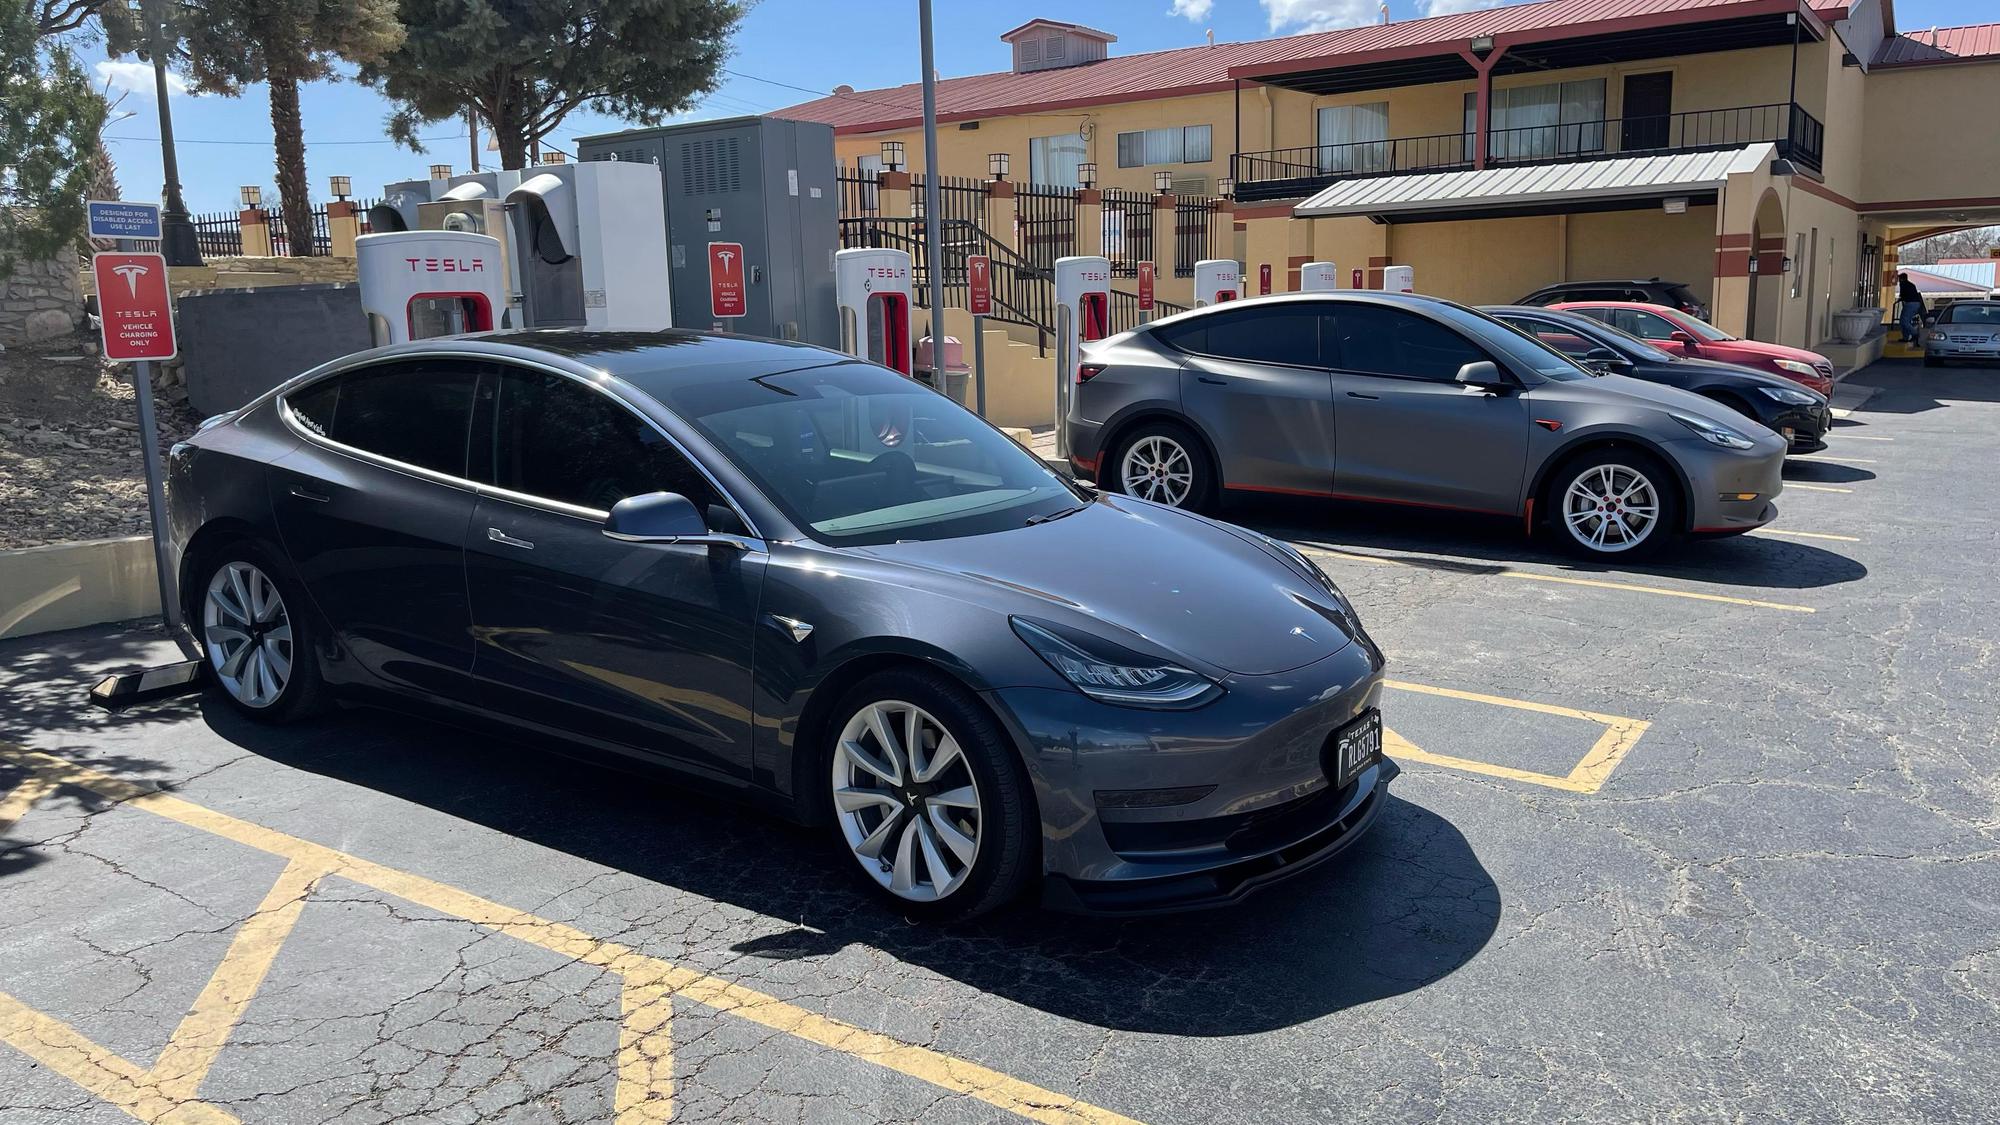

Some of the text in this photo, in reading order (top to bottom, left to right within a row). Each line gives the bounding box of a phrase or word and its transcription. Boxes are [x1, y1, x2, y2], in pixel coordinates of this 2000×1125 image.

[406, 258, 484, 272] TESLA
[868, 267, 906, 278] TESLA
[1081, 272, 1107, 281] TESLA
[116, 310, 157, 318] TESLA
[120, 331, 158, 339] CHARGING
[1350, 720, 1370, 740] TEXAS
